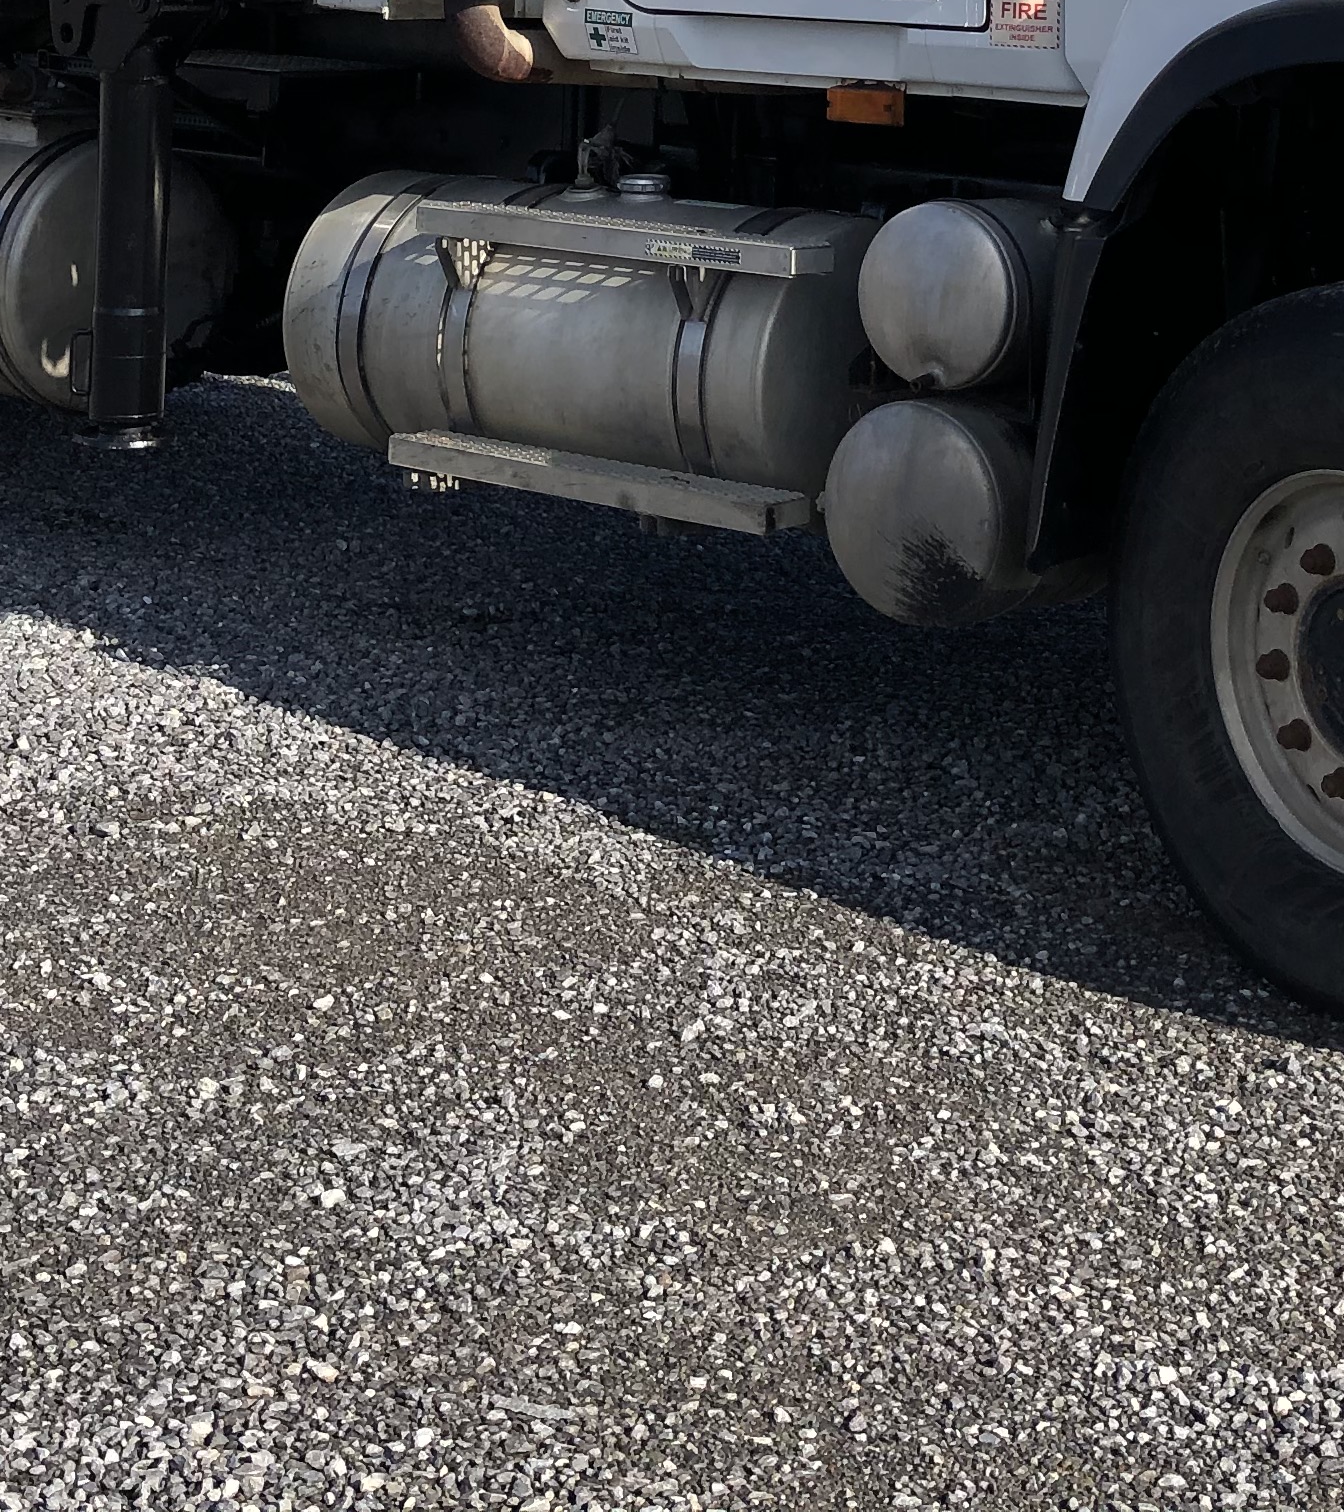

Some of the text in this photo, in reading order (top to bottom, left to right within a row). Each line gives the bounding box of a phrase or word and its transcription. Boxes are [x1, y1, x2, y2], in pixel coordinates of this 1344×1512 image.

[1001, 1, 1048, 21] FIRE
[586, 10, 631, 25] EMERGENCY
[995, 23, 1054, 33] EXTINGUISHER
[1009, 34, 1036, 42] INSIDE
